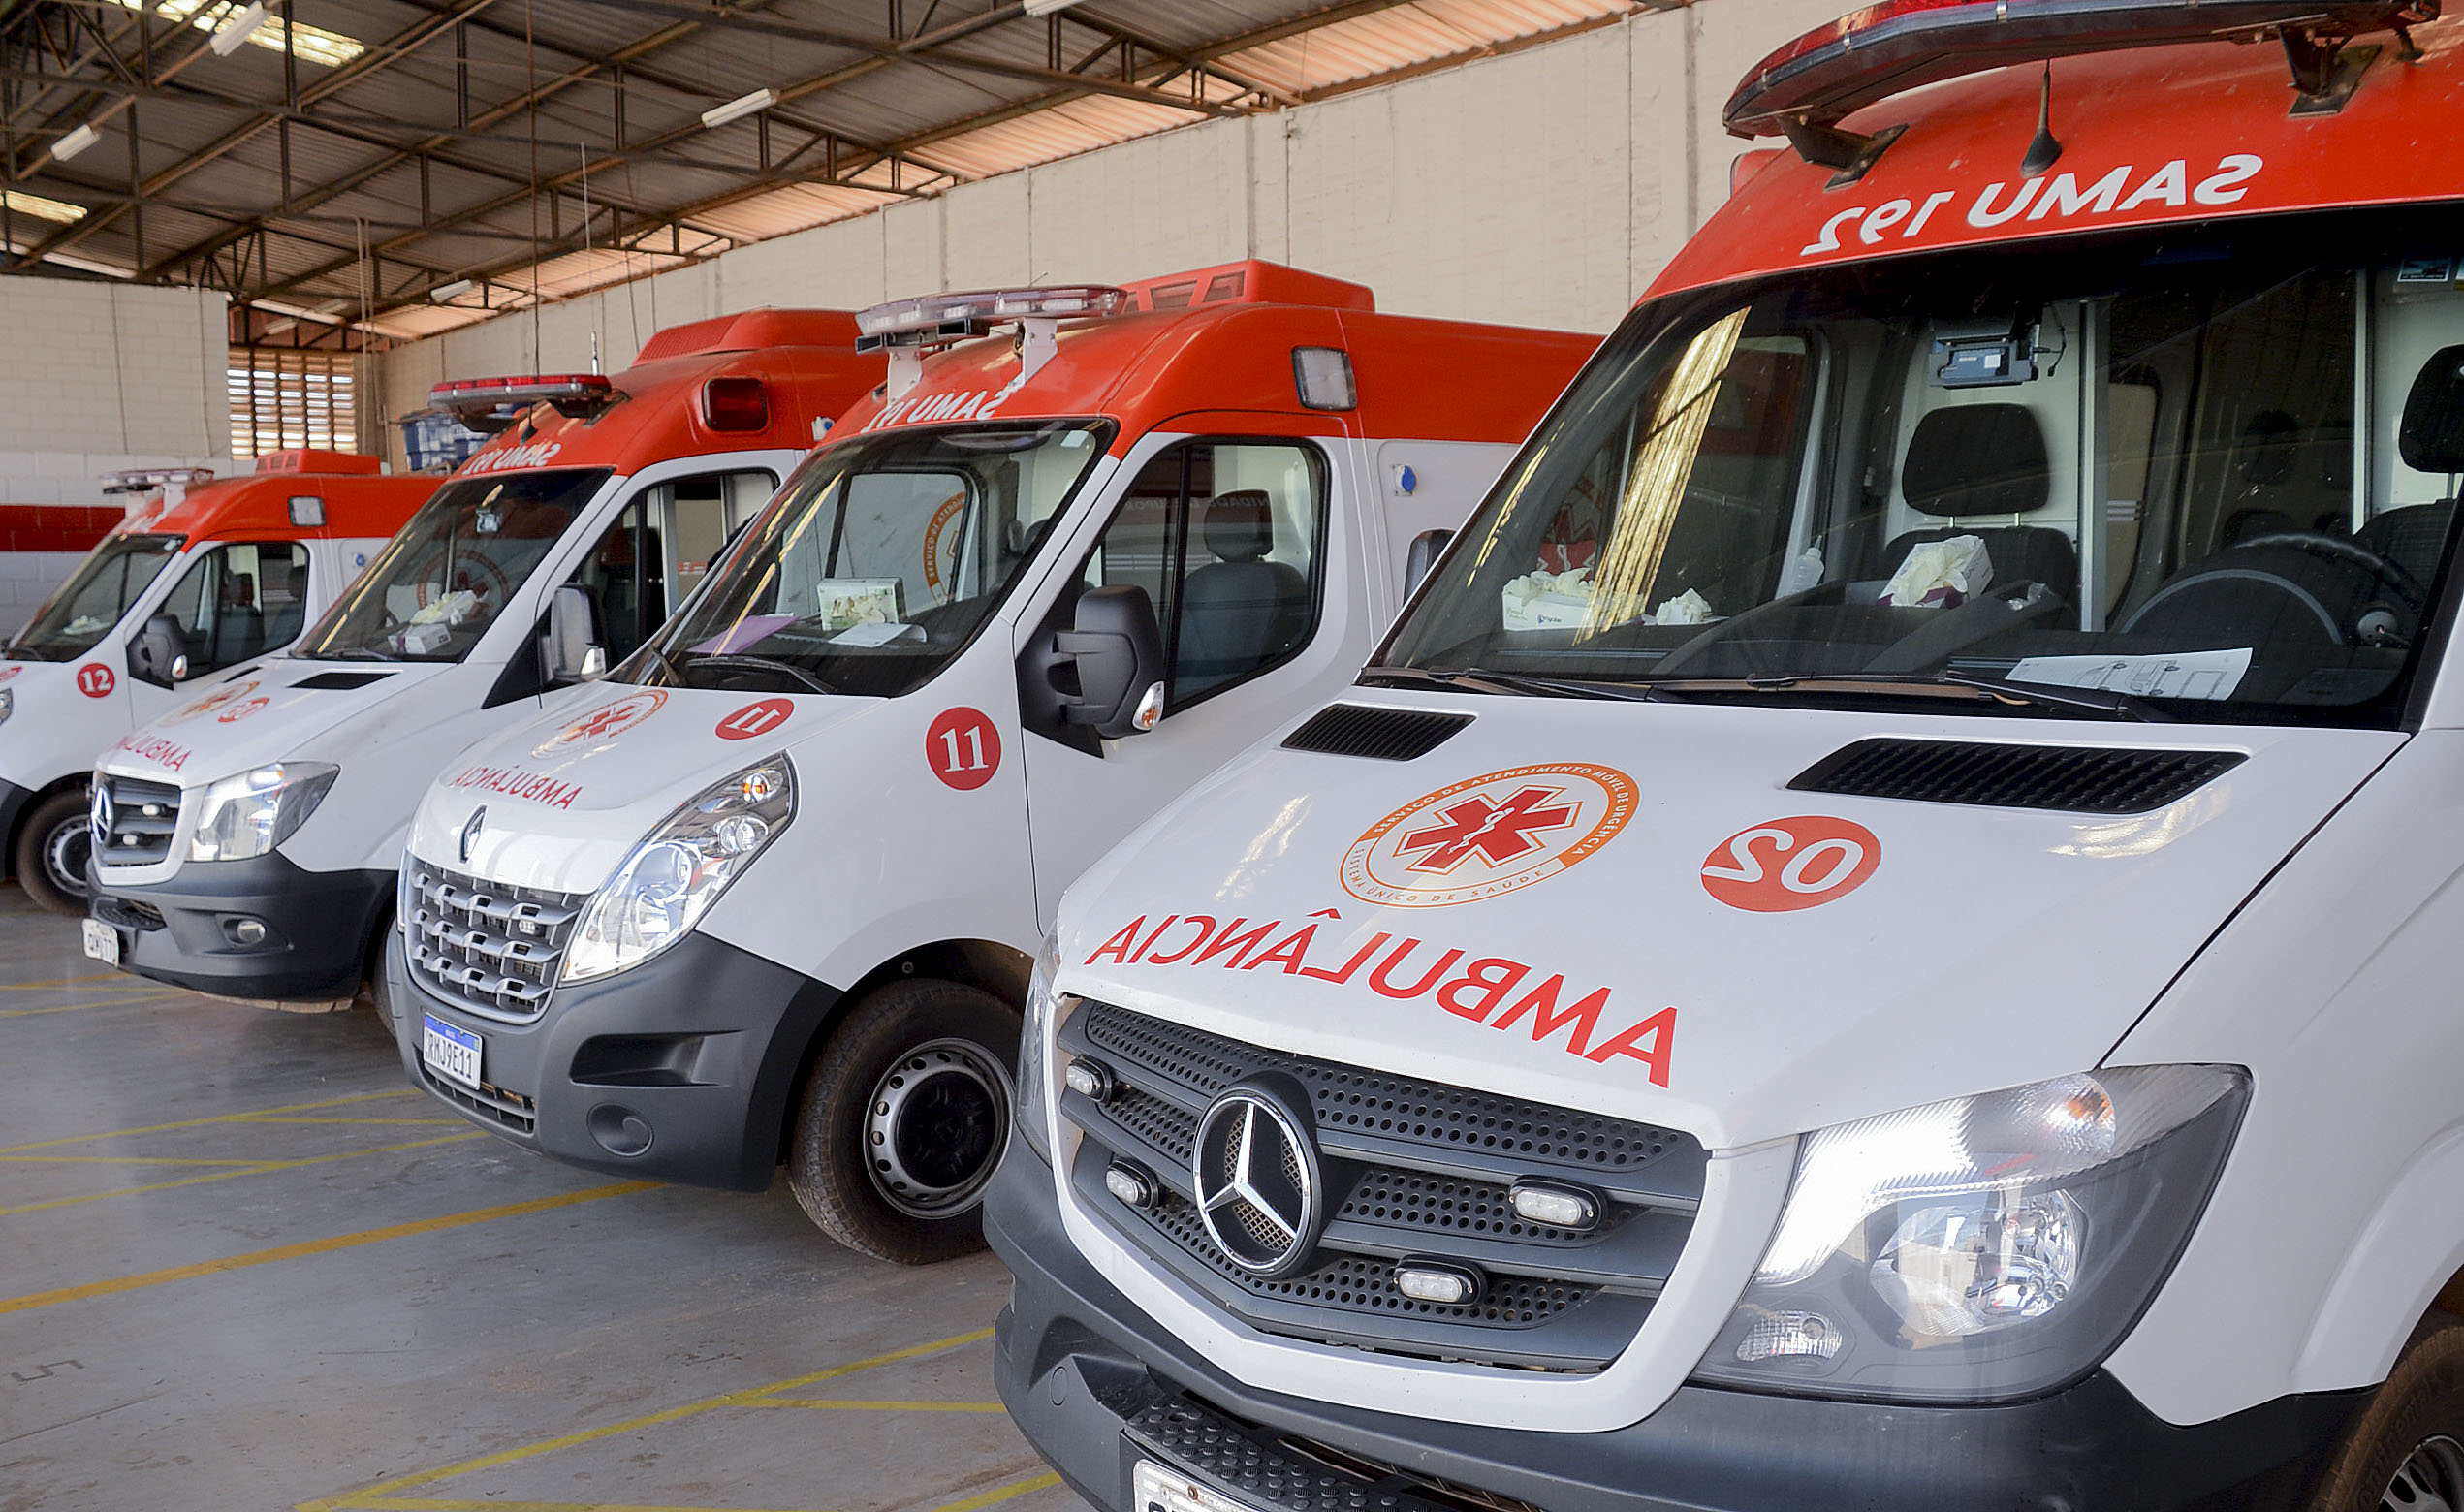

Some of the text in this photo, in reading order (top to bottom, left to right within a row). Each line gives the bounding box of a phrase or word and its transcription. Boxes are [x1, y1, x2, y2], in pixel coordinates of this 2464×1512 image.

[83, 669, 111, 692] 12
[939, 725, 990, 772] 11
[1374, 765, 1629, 855] SERVIÇO DE ATENDIMENTO MÓVEL DE URGÊNCIA
[1348, 848, 1544, 902] SISTEMA ÚNICO DE SAÚDE
